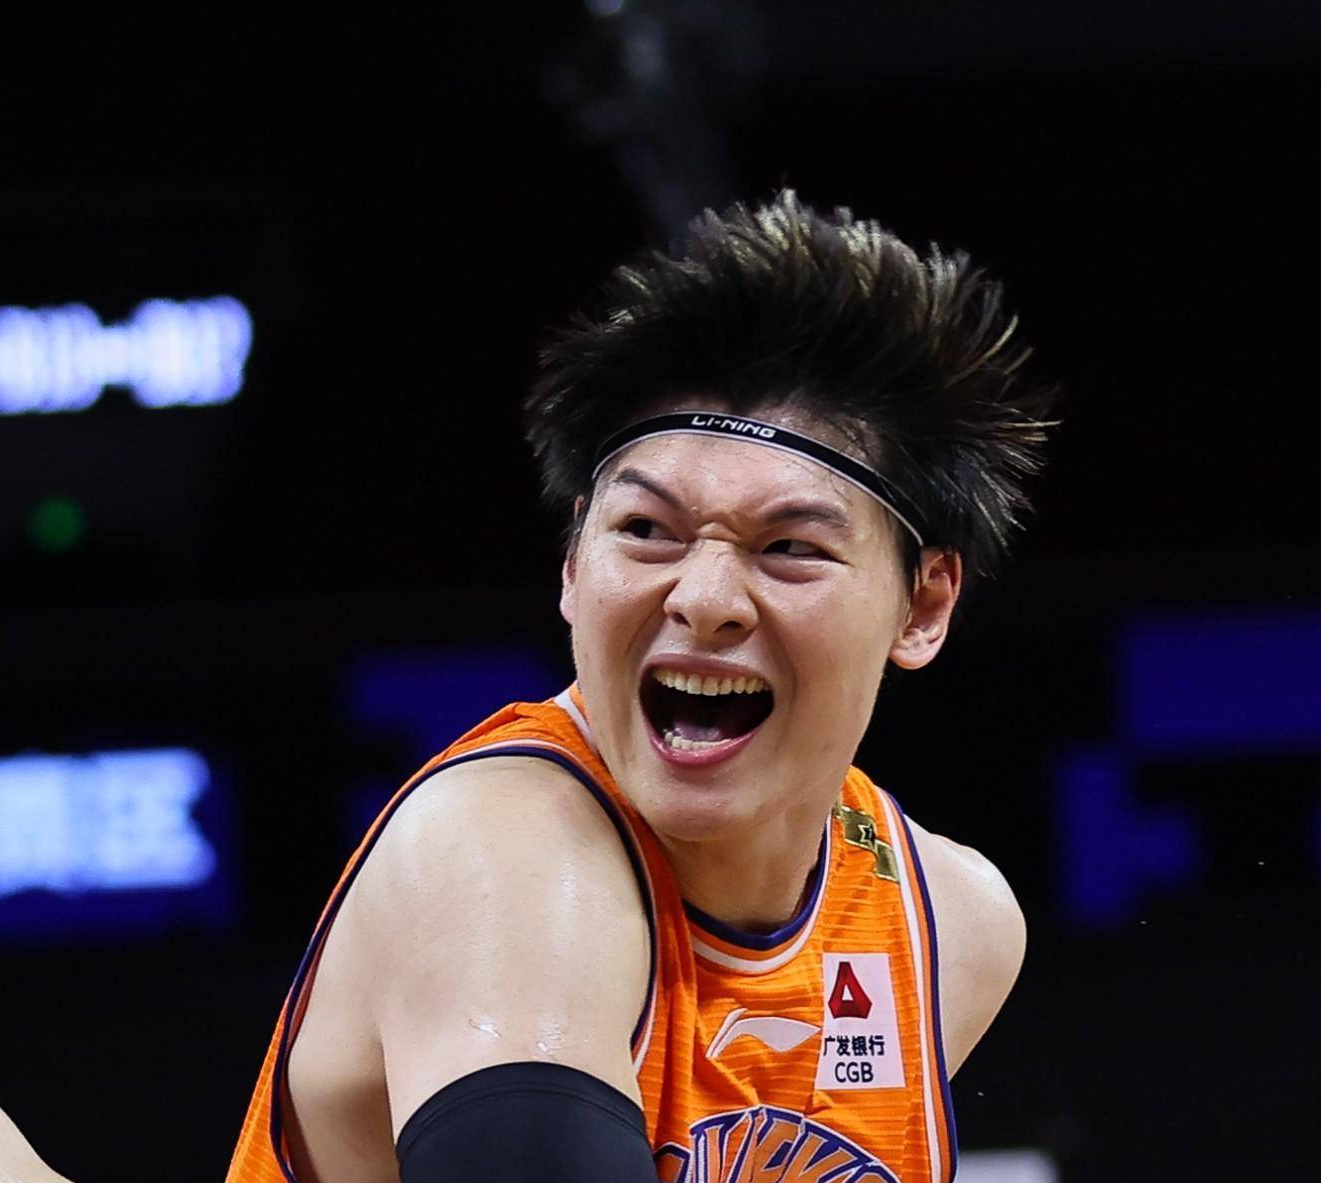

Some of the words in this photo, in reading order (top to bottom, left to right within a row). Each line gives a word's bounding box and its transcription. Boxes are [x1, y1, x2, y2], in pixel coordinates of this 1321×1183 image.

[691, 416, 777, 438] LI-NING
[823, 1034, 885, 1056] 广发银行
[835, 1062, 874, 1083] CGB
